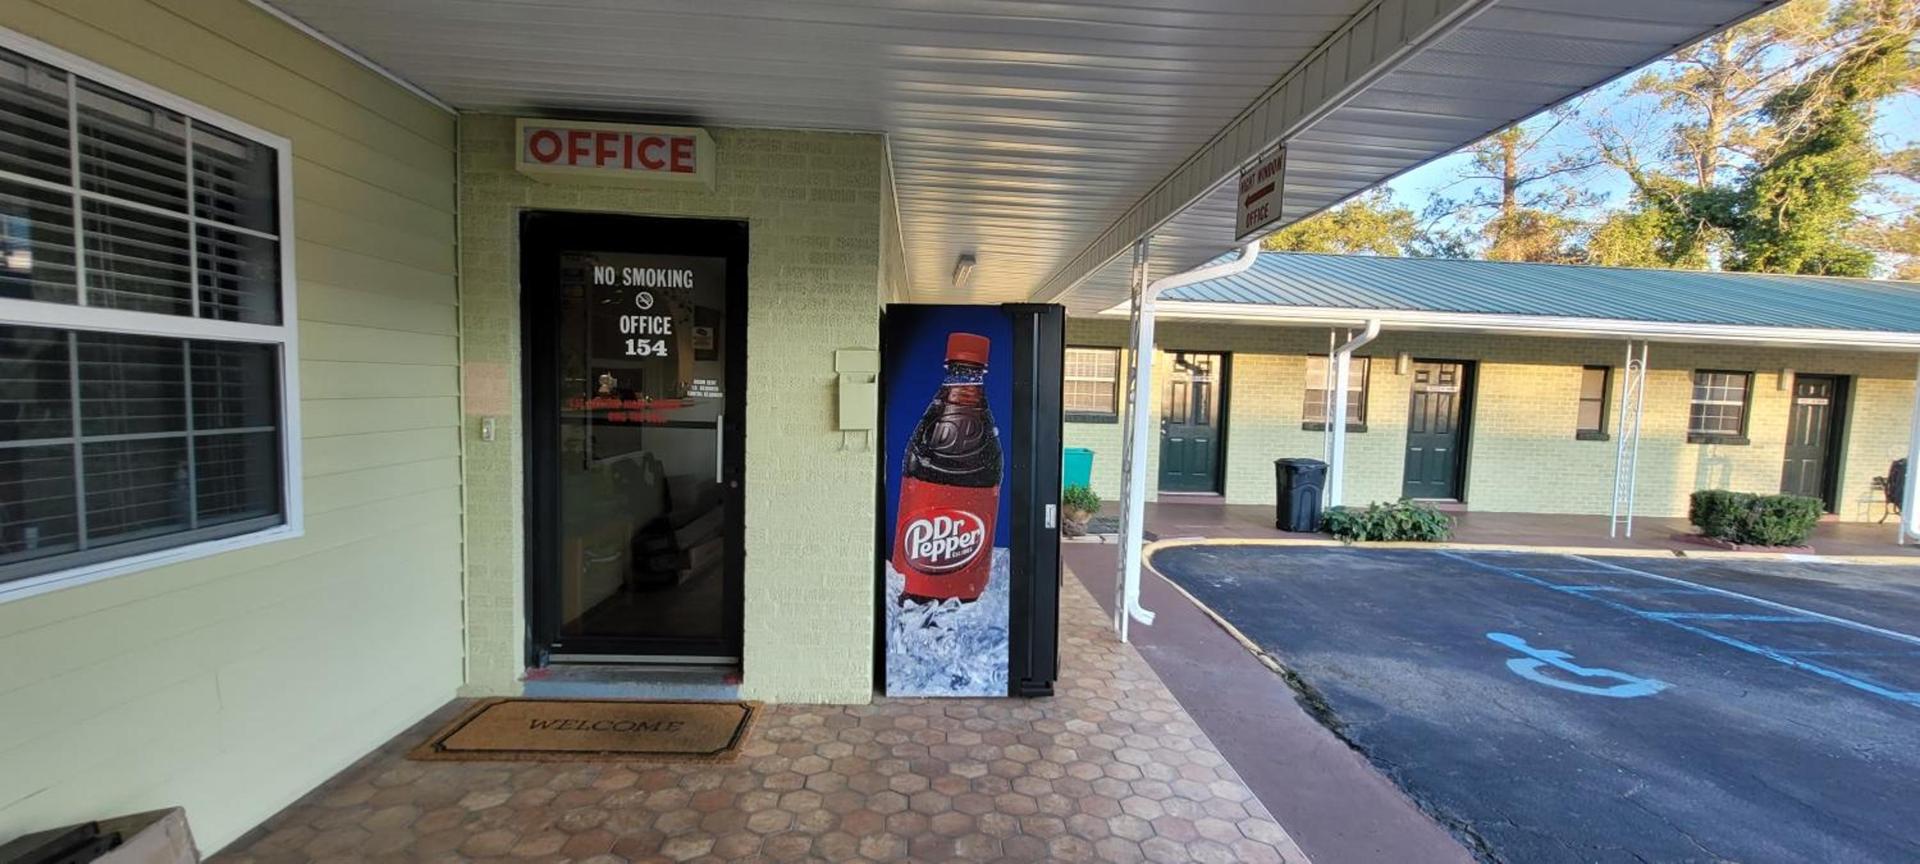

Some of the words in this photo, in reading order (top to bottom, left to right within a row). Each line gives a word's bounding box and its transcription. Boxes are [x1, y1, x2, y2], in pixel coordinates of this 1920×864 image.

[529, 129, 694, 173] OFFICE
[1246, 202, 1269, 228] OFFICE
[594, 266, 615, 285] NO
[623, 267, 693, 288] SMOKING
[619, 315, 672, 335] OFFICE
[625, 338, 668, 356] 154
[933, 515, 965, 540] Dr
[905, 519, 980, 562] Pepper
[530, 718, 684, 732] WELCOME
